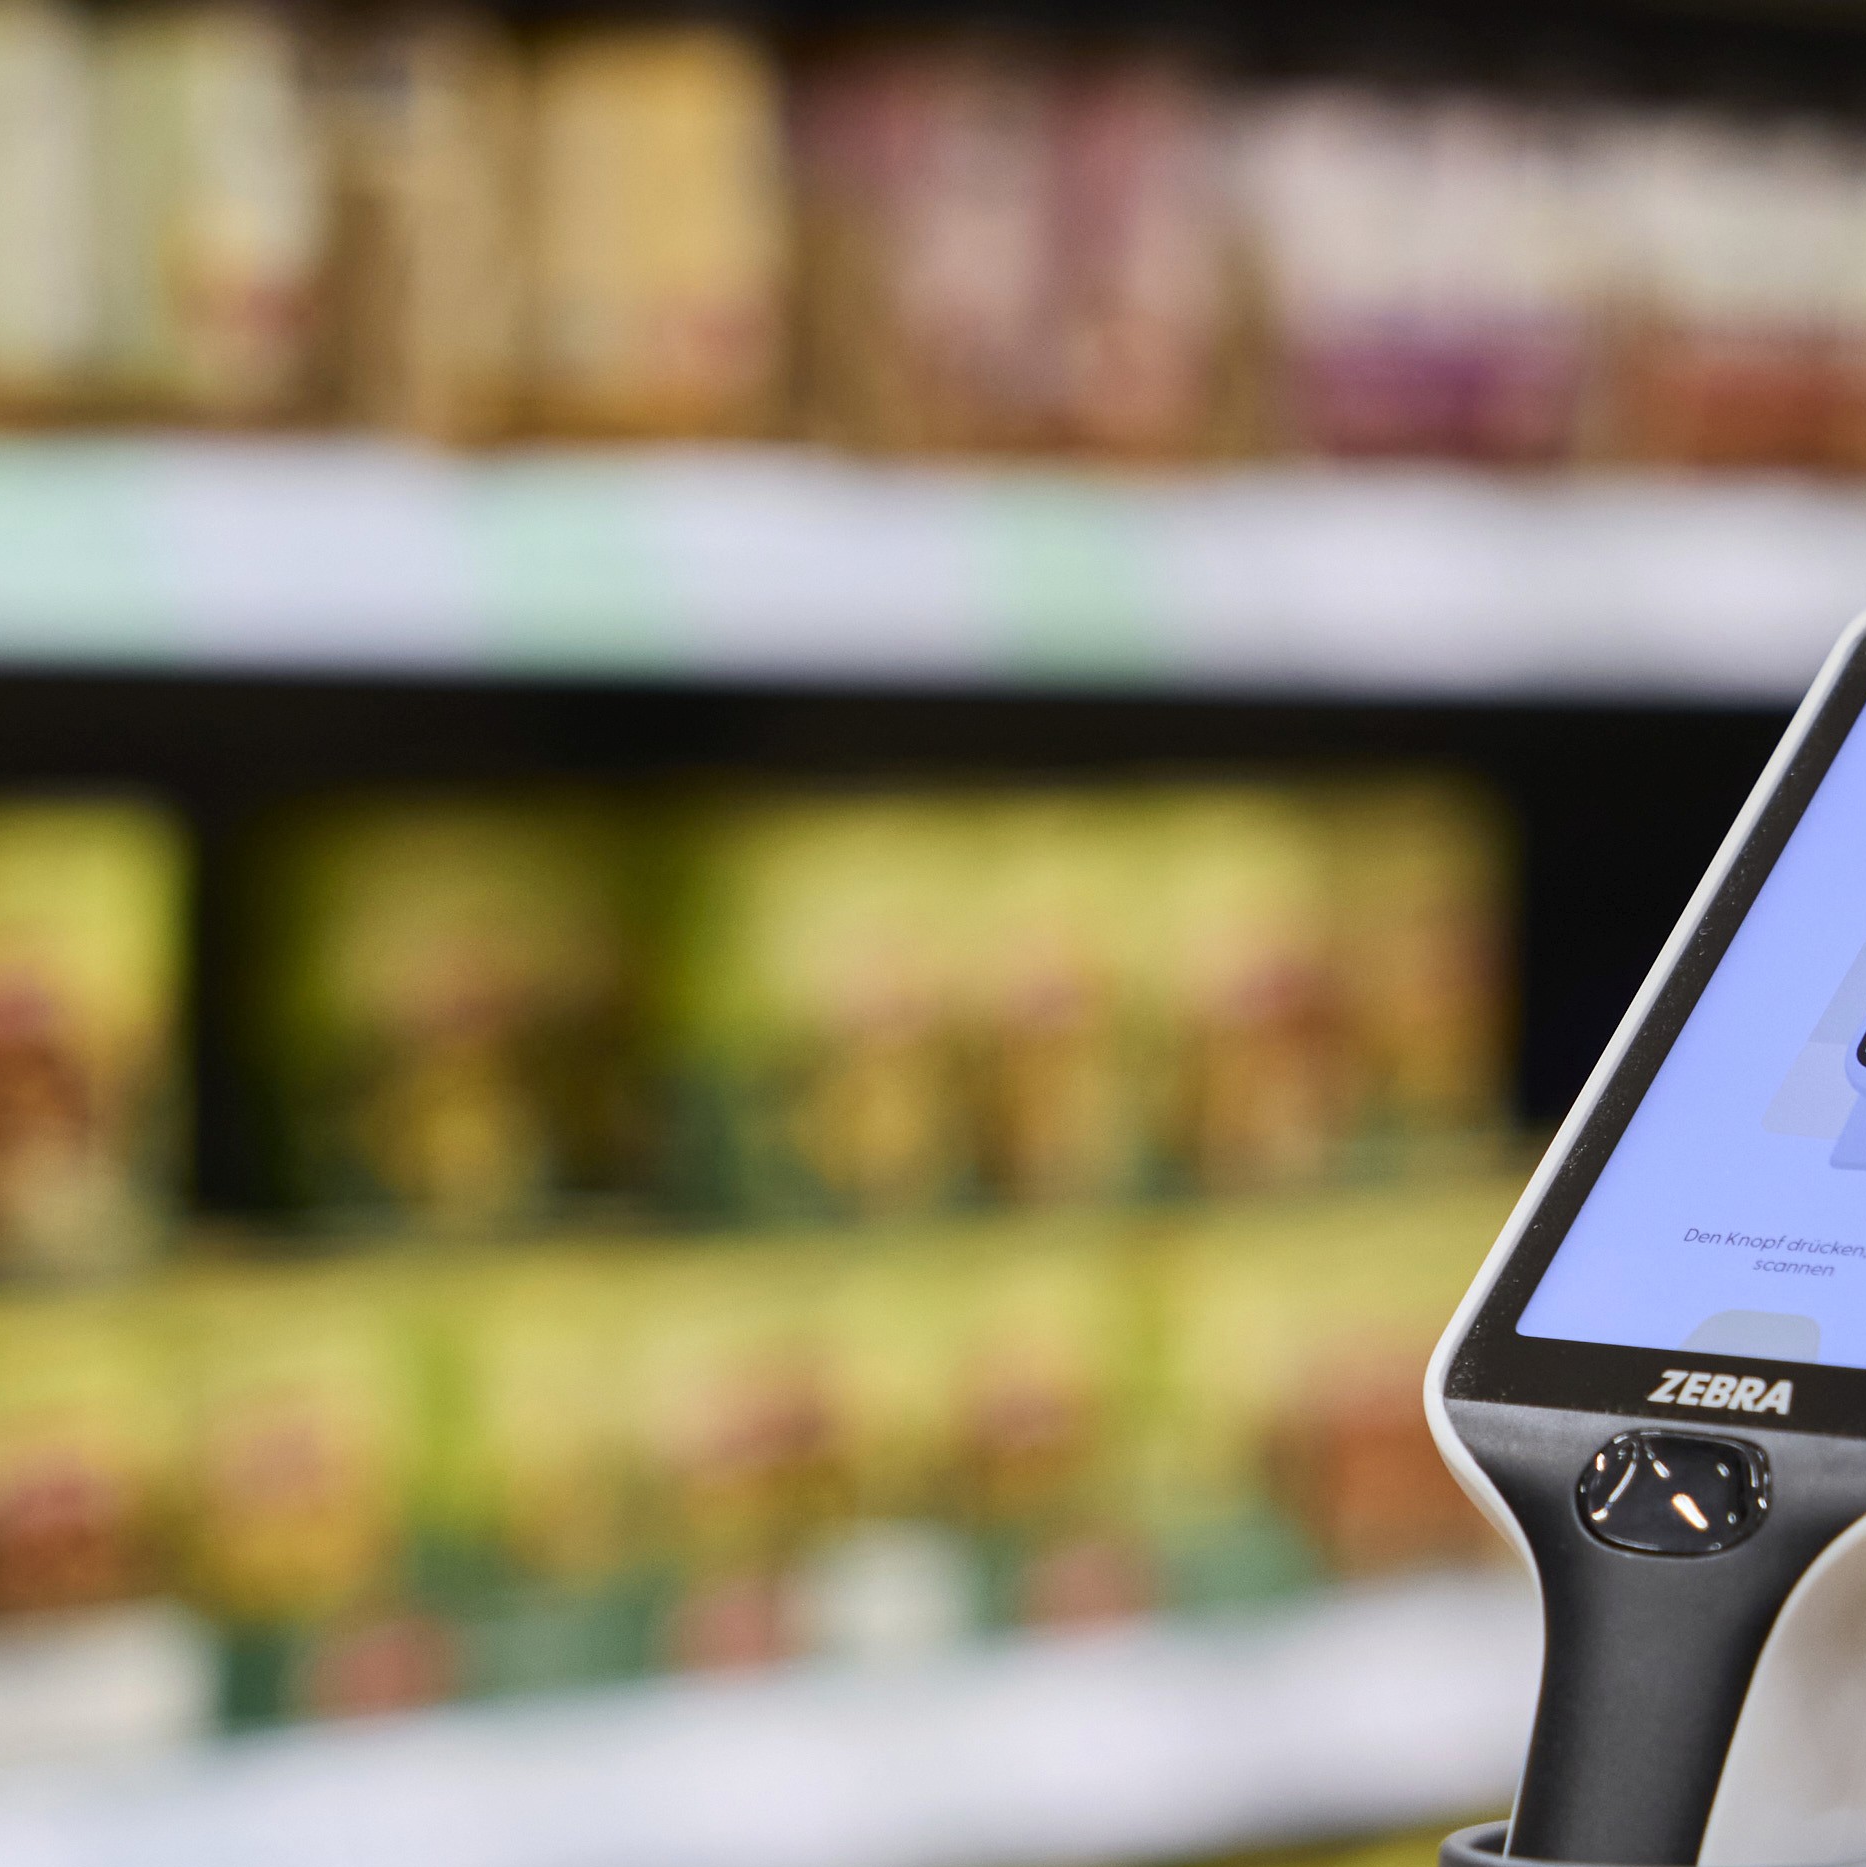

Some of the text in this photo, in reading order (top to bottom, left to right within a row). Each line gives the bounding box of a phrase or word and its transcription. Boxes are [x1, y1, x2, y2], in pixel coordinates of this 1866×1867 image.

[1684, 1228, 1721, 1245] Den
[1724, 1232, 1787, 1252] Knopf
[1753, 1258, 1834, 1278] scannen
[1647, 1368, 1794, 1416] ZEBRA
